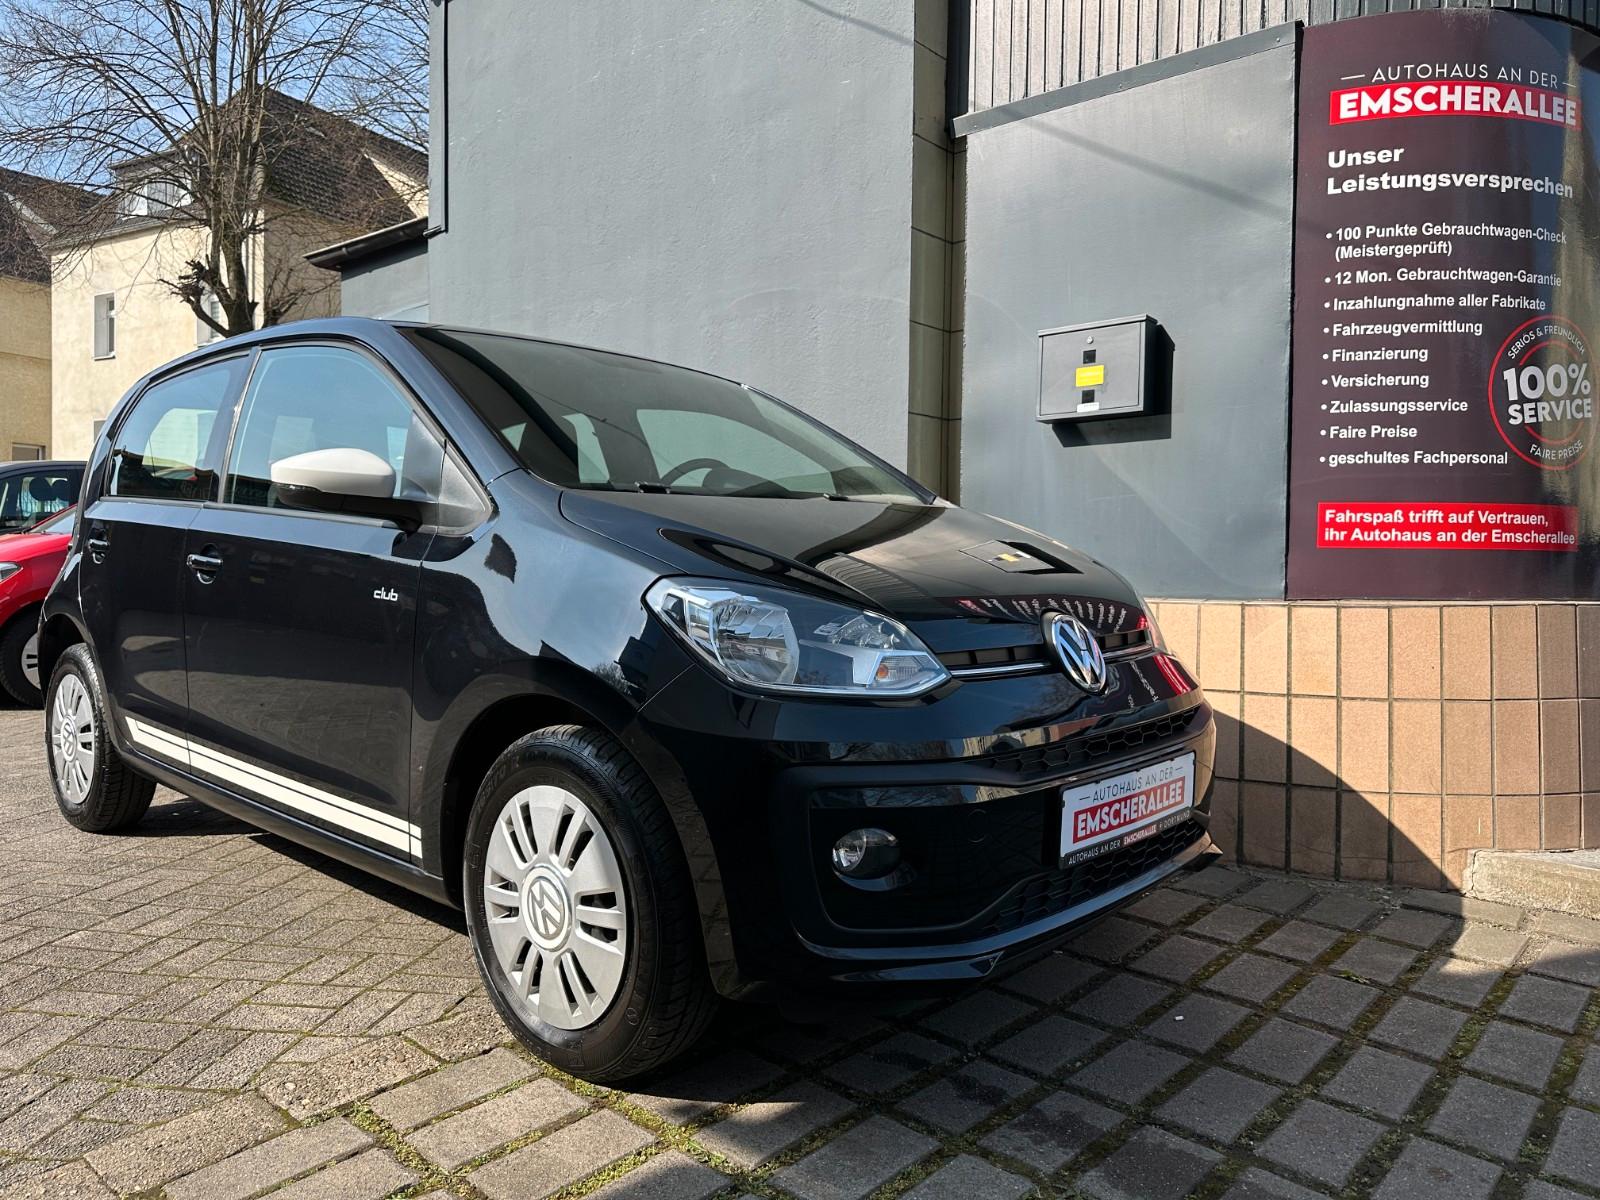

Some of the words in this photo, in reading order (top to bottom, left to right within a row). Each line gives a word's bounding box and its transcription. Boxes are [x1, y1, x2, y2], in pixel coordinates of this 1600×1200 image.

[1371, 63, 1489, 83] AUTOHAUS
[1497, 66, 1522, 82] AN
[1530, 70, 1558, 89] DER
[1339, 85, 1577, 126] EMSCHERALLEE
[1328, 147, 1405, 168] Unser
[1327, 171, 1573, 198] Leistungsversprechen
[1336, 226, 1362, 242] 100
[1365, 222, 1418, 240] Punkte
[1421, 222, 1567, 245] Gebrauchtwagen-Check
[1335, 240, 1453, 262] (Meistergeprüft)
[1334, 272, 1352, 285] 12
[1355, 270, 1392, 284] Mon.
[1396, 267, 1562, 287] Gebrauchtwagen-Garantie
[1333, 295, 1455, 311] Inzahlungnahme
[1458, 294, 1489, 307] aller
[1491, 294, 1546, 311] Fabrikate
[1332, 320, 1483, 338] Fahrzeugvermittlung
[1536, 327, 1543, 336] &
[1544, 325, 1585, 355] FREUNDLICH
[1331, 347, 1429, 363] Finanzierung
[1331, 373, 1430, 389] Versicherung
[1503, 363, 1591, 400] 100%
[1329, 398, 1468, 415] Zulassungsservice
[1508, 398, 1592, 425] SERVICE
[1329, 426, 1366, 439] Faire
[1370, 425, 1418, 438] Preise
[1328, 452, 1410, 467] geschultes
[1413, 451, 1509, 466] Fachpersonal
[1530, 444, 1556, 460] FAIRE
[1558, 439, 1583, 460] PREISE
[1324, 510, 1404, 525] Fahrspaß
[1408, 509, 1444, 524] trifft
[1448, 510, 1474, 524] auf
[1477, 510, 1549, 527] Vertrauen,
[1324, 528, 1347, 541] ihr
[1350, 528, 1432, 543] Autohaus
[1436, 531, 1457, 543] an
[1461, 530, 1488, 543] der
[1491, 530, 1575, 545] Emscherallee
[373, 586, 398, 601] club
[1092, 776, 1142, 803] AUTOHAUS
[1145, 774, 1157, 787] AN
[1160, 767, 1173, 781] DER
[1077, 780, 1183, 838] EMSCHERALLEE
[1068, 848, 1099, 865] AUTOHAUS
[1110, 840, 1121, 850] DER
